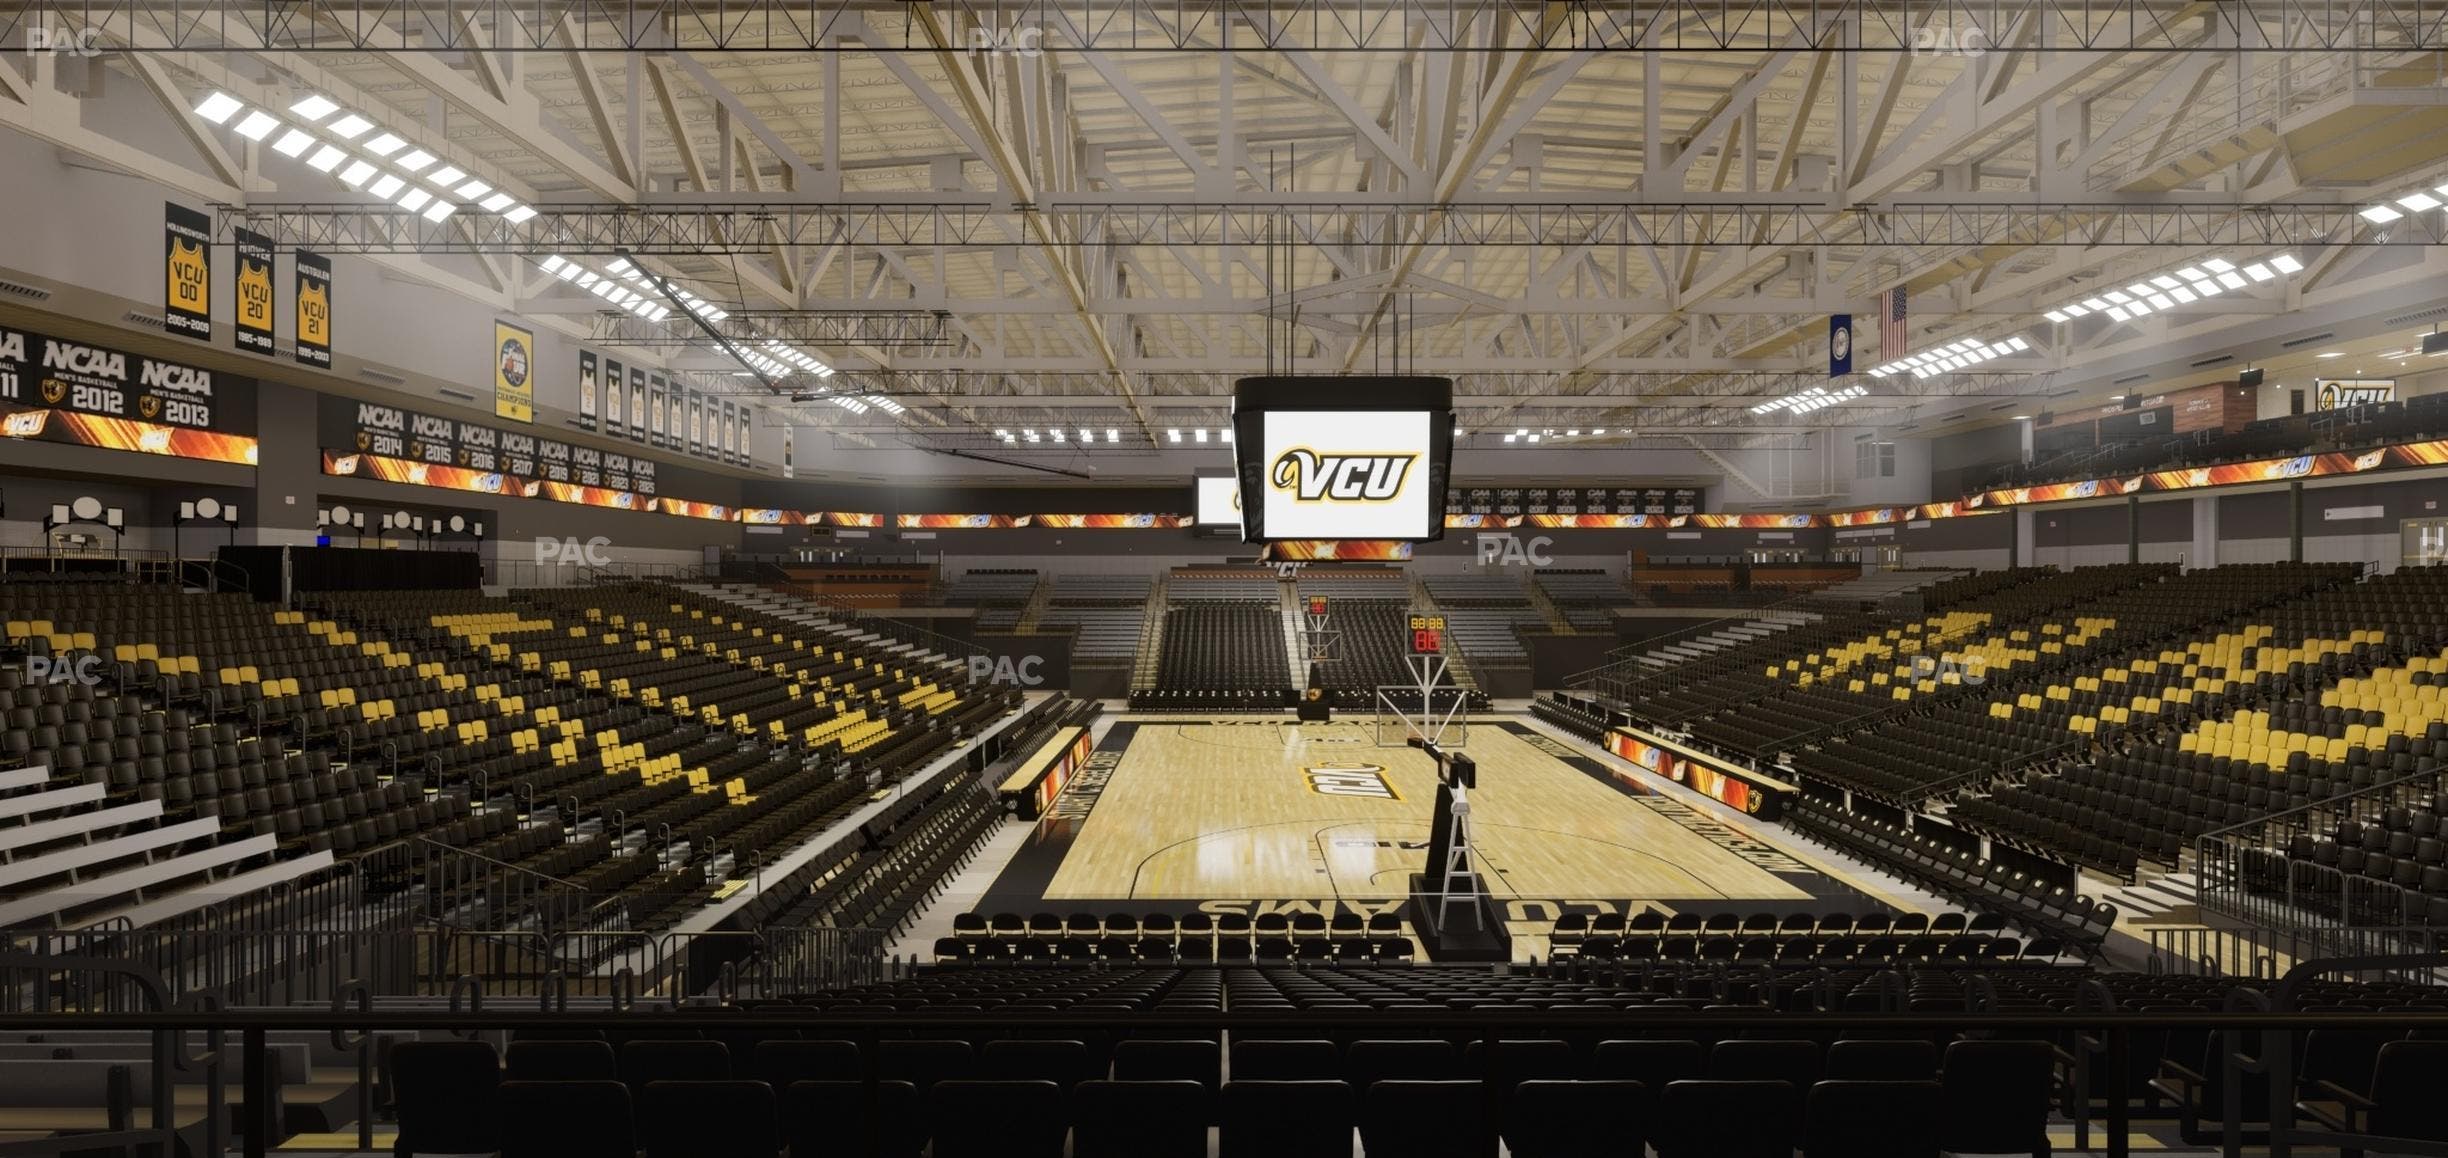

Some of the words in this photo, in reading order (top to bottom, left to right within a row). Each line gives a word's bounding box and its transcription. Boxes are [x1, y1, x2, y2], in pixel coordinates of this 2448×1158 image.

[174, 262, 204, 285] VCU
[180, 283, 198, 302] 00
[242, 283, 268, 304] VCU
[247, 301, 263, 320] 20
[302, 300, 326, 320] VCU
[308, 318, 319, 335] 21
[42, 339, 127, 380] NCAA
[140, 359, 212, 396] NCAA
[72, 384, 124, 415] 2012
[165, 400, 210, 427] 2013
[358, 403, 404, 431] NCAA
[411, 413, 453, 440] NCAA
[459, 423, 496, 448] NCAA
[373, 435, 403, 456] 2014
[425, 444, 451, 463] 2015
[501, 432, 534, 455] NCAA
[539, 440, 569, 461] NCAA
[471, 451, 495, 470] 2016
[573, 446, 600, 467] NCAA
[1273, 448, 1417, 501] VCU
